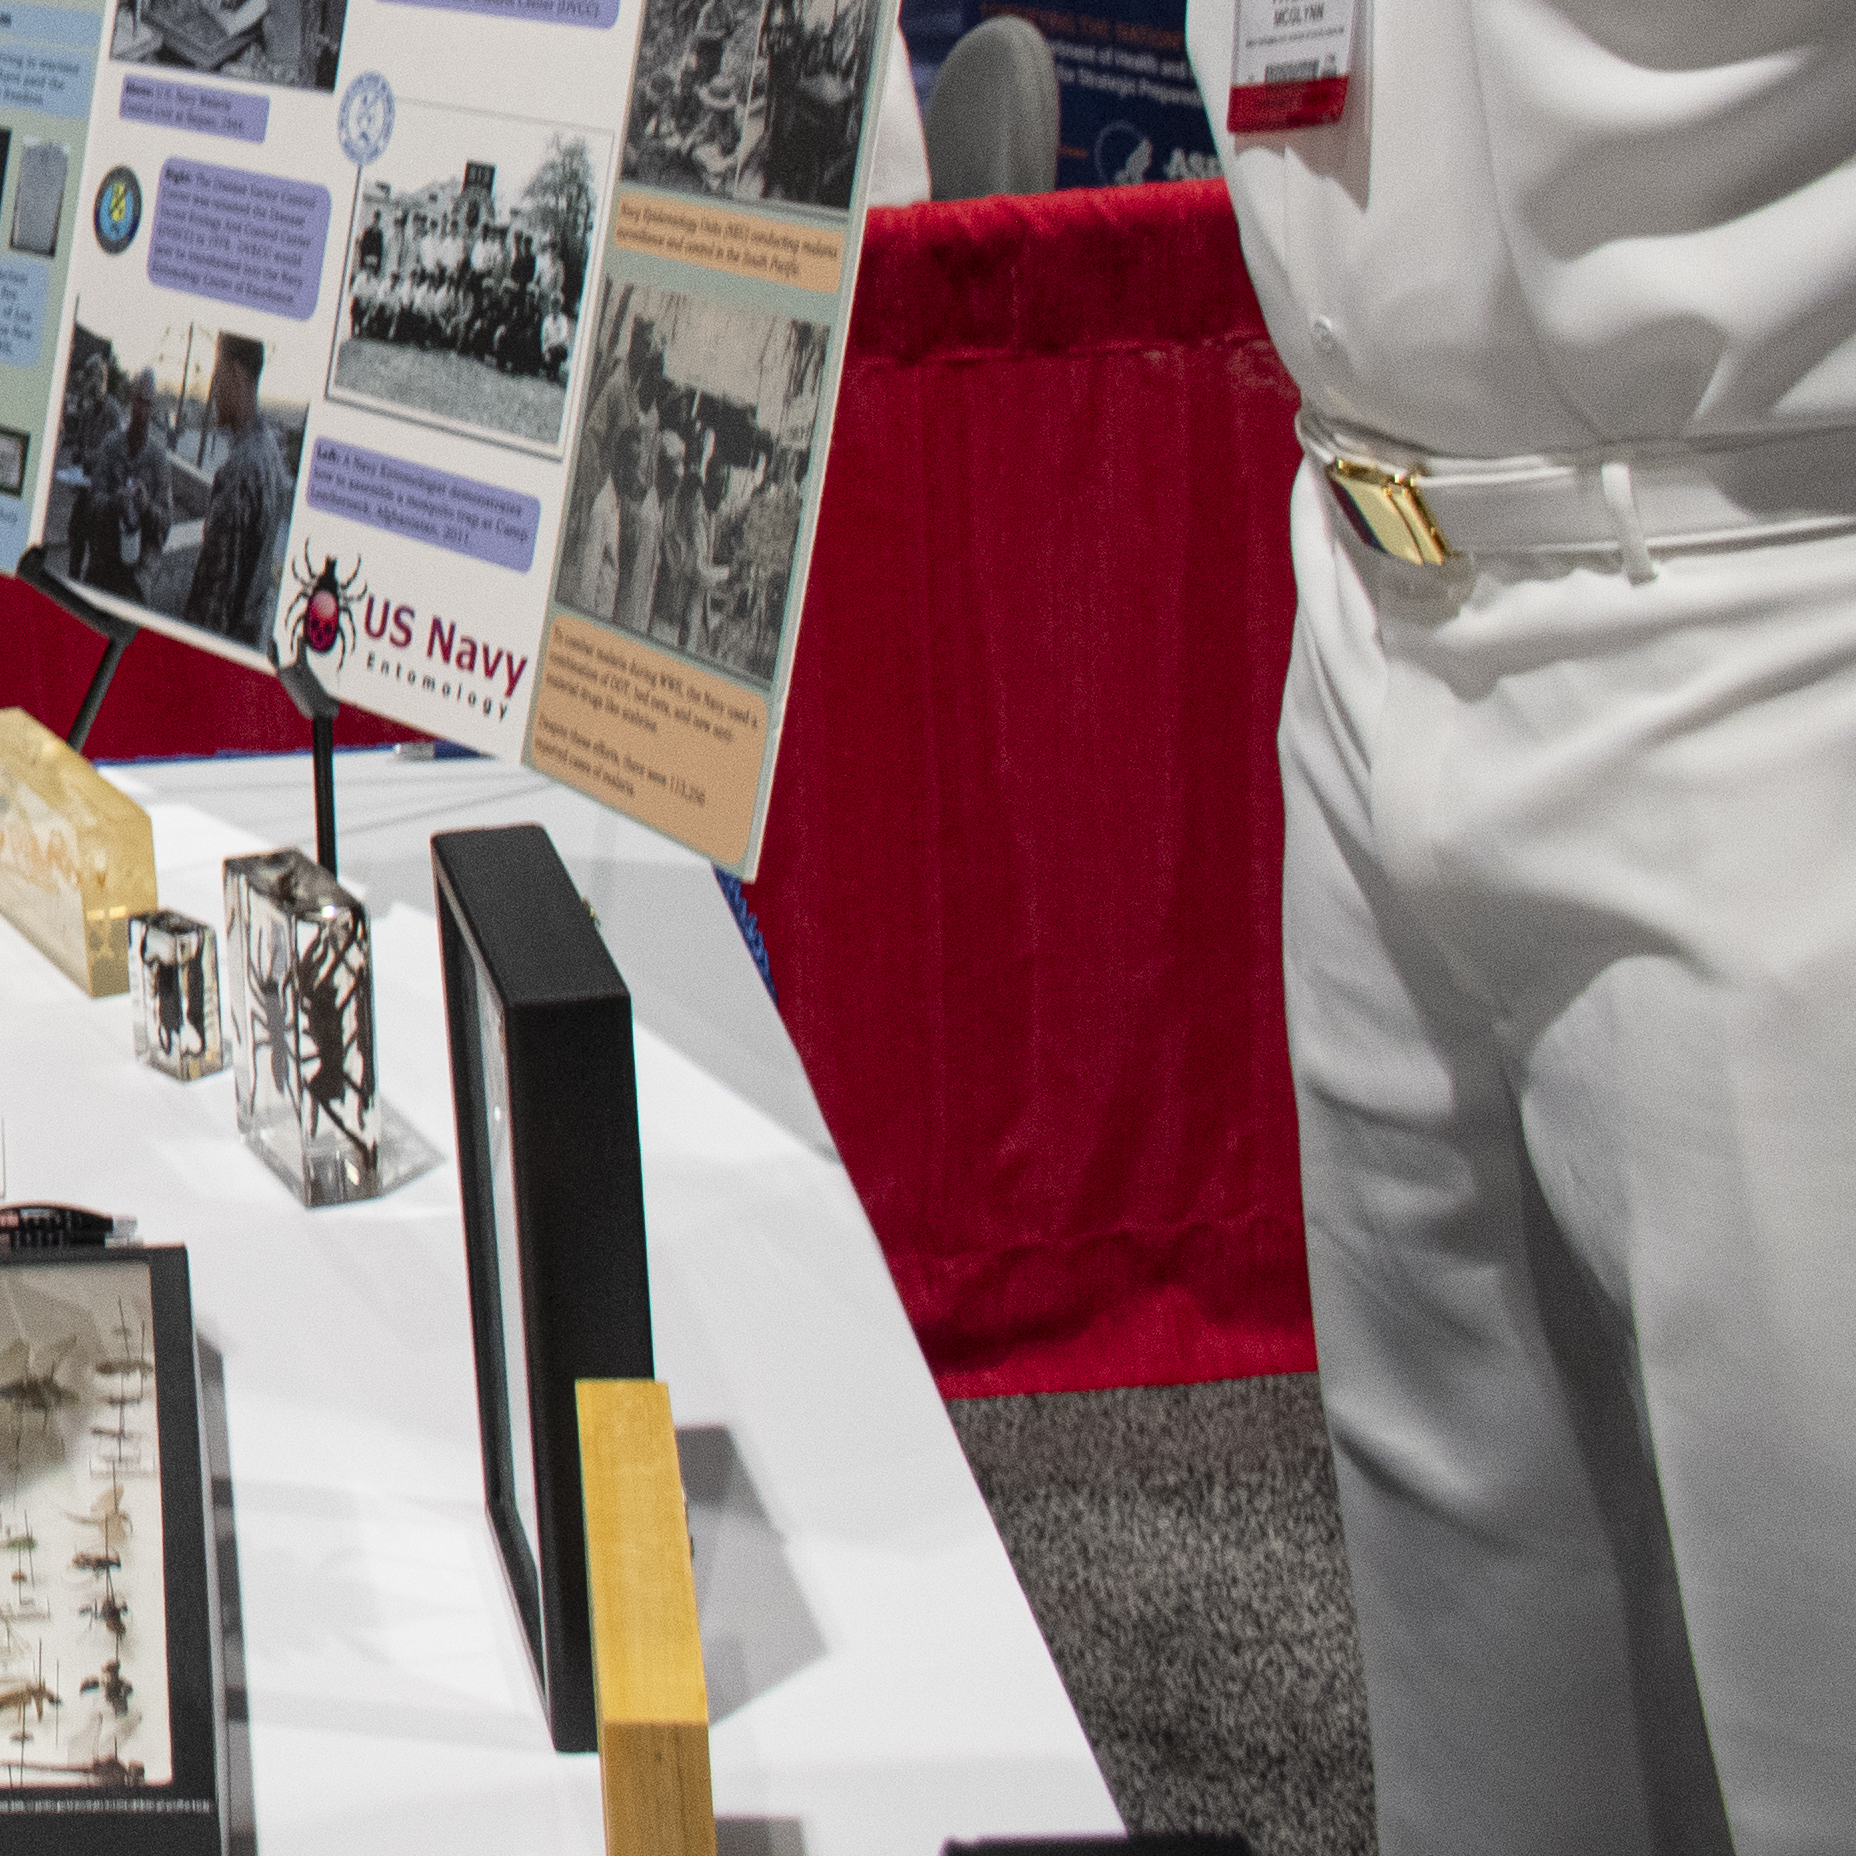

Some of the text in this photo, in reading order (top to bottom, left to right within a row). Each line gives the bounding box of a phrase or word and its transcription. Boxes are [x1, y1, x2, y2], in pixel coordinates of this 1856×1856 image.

[363, 594, 528, 699] US Navy
[366, 651, 508, 722] Entomology
